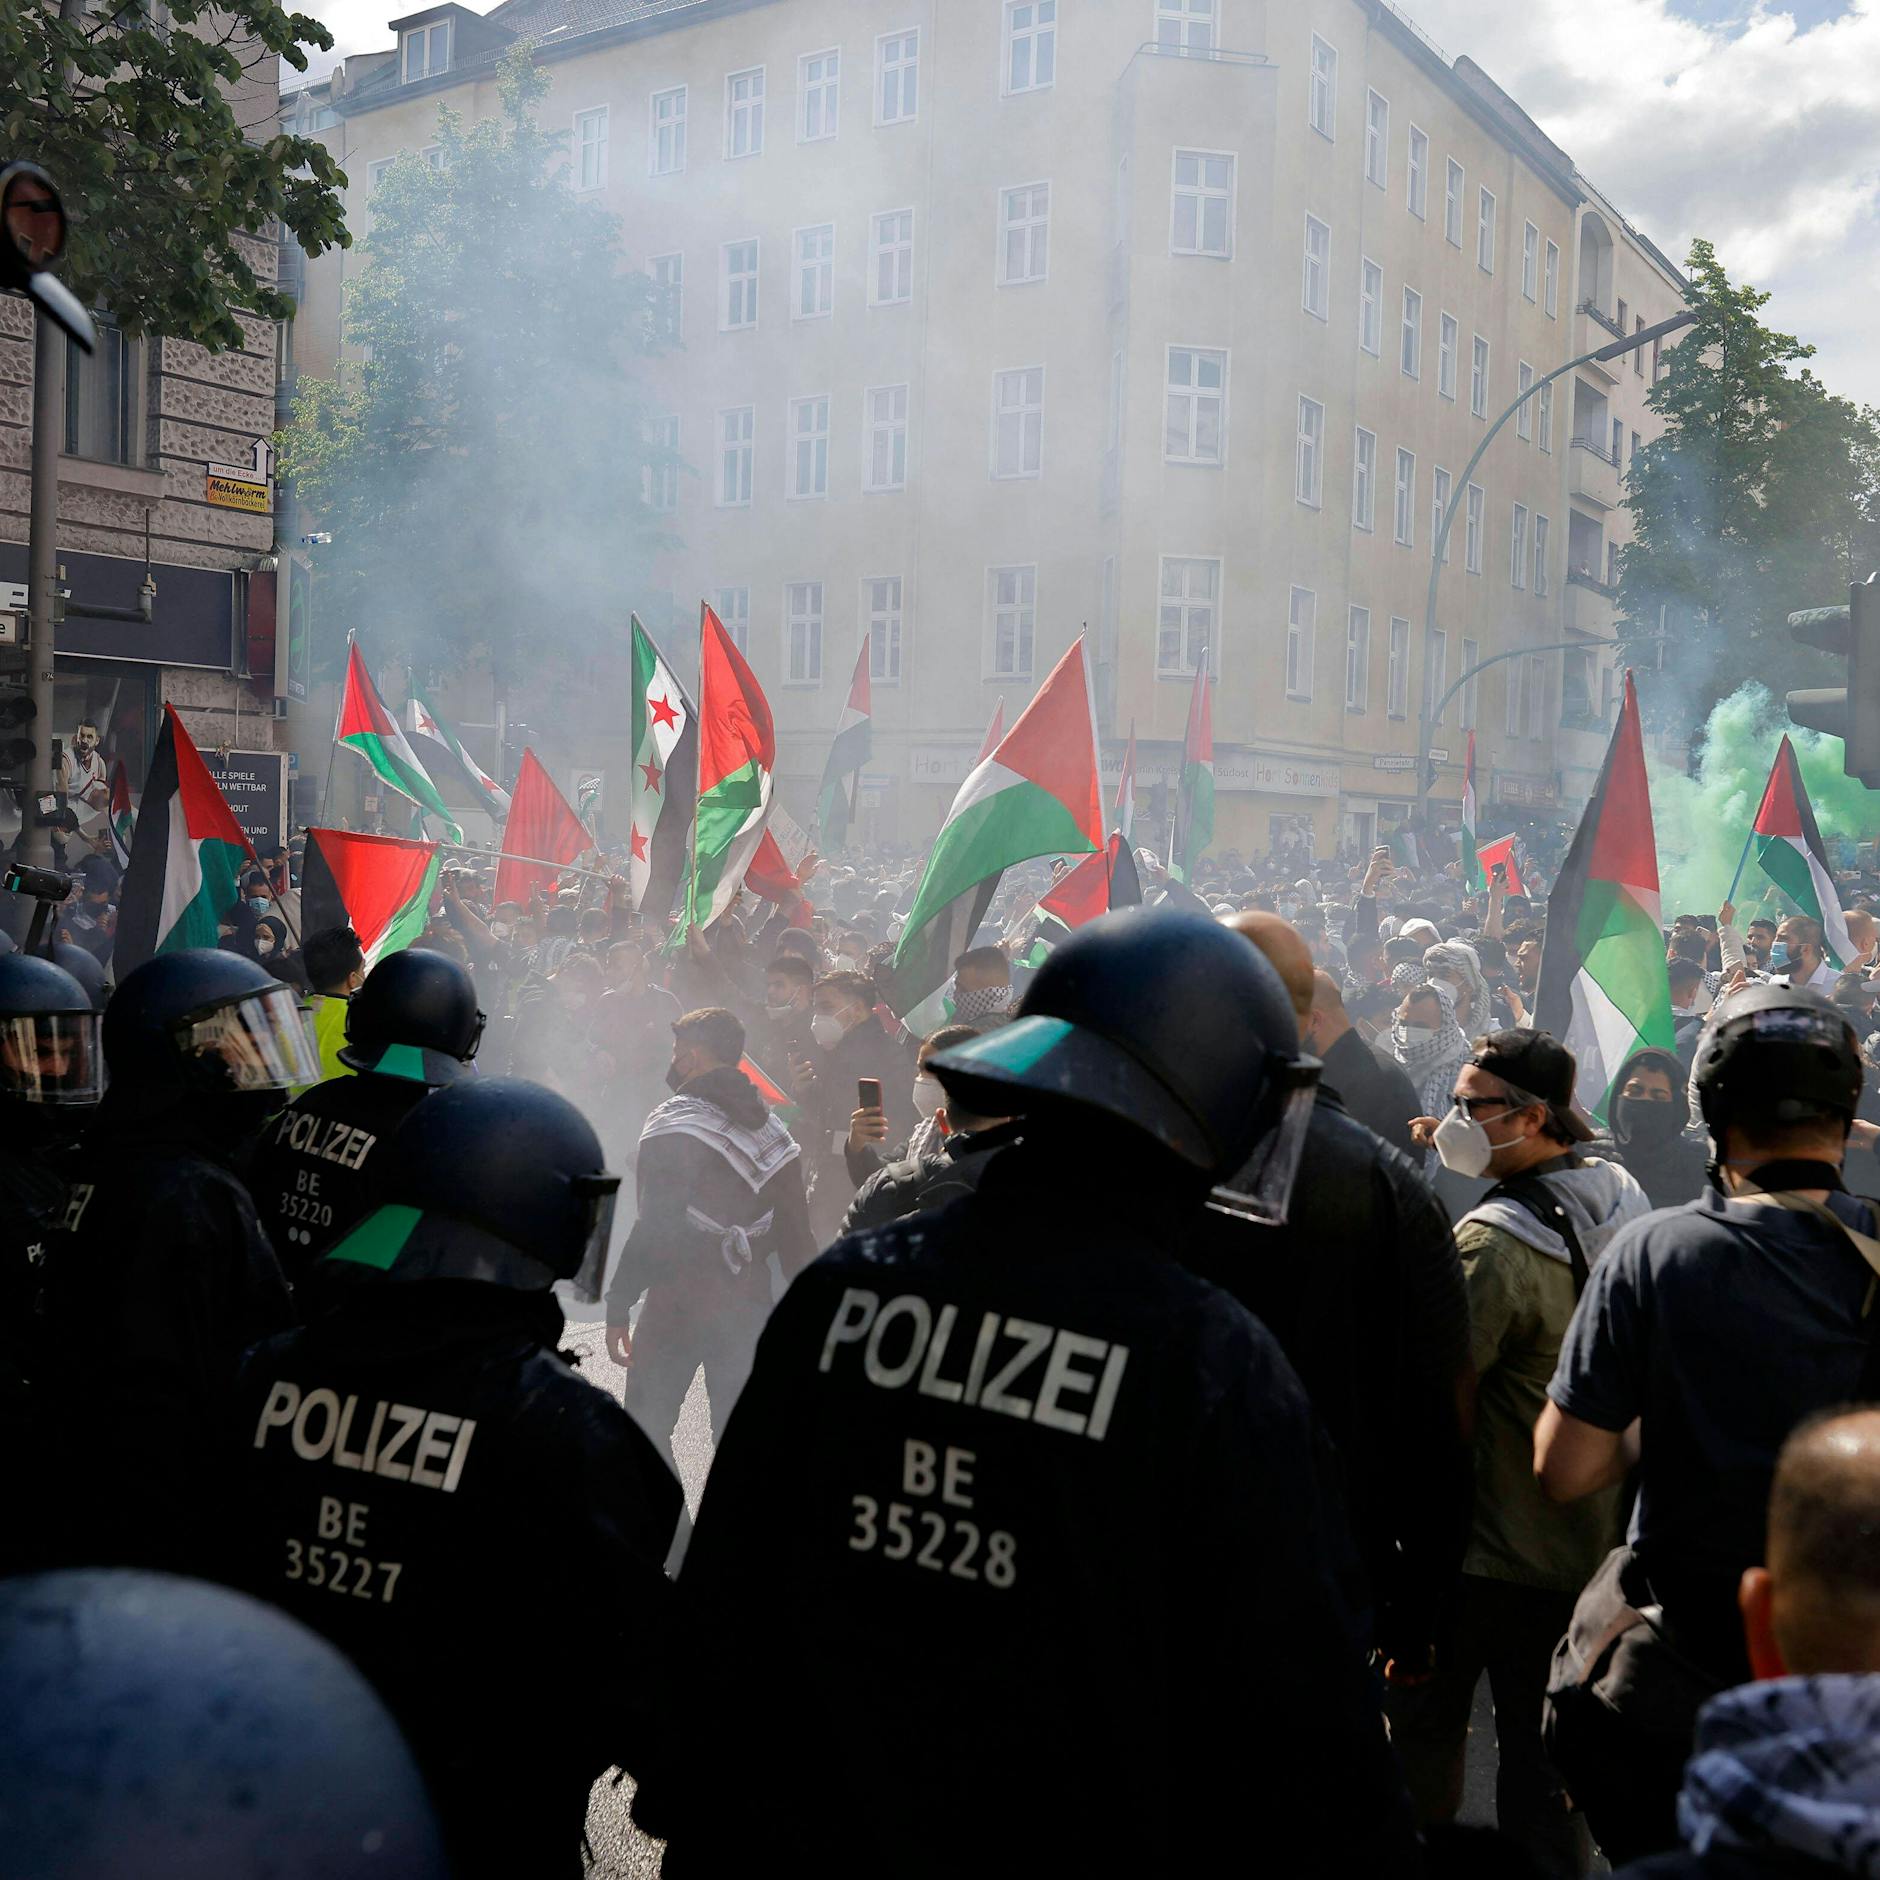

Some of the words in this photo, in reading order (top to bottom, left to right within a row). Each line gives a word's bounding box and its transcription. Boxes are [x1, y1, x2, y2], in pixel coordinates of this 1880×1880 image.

[225, 467, 236, 475] die
[237, 469, 254, 479] Ecke
[228, 771, 255, 780] SPIELE
[230, 782, 267, 791] WETTBAR
[251, 826, 268, 834] UND
[275, 1110, 377, 1170] POLIZEI
[280, 1192, 333, 1227] 35220
[296, 1169, 321, 1197] BE
[818, 1287, 1130, 1441] POLIZEI
[253, 1380, 478, 1493] POLIZEI
[902, 1437, 977, 1509] BE
[317, 1495, 370, 1548] BE
[848, 1494, 1017, 1589] 35228
[285, 1538, 403, 1604] 35227
